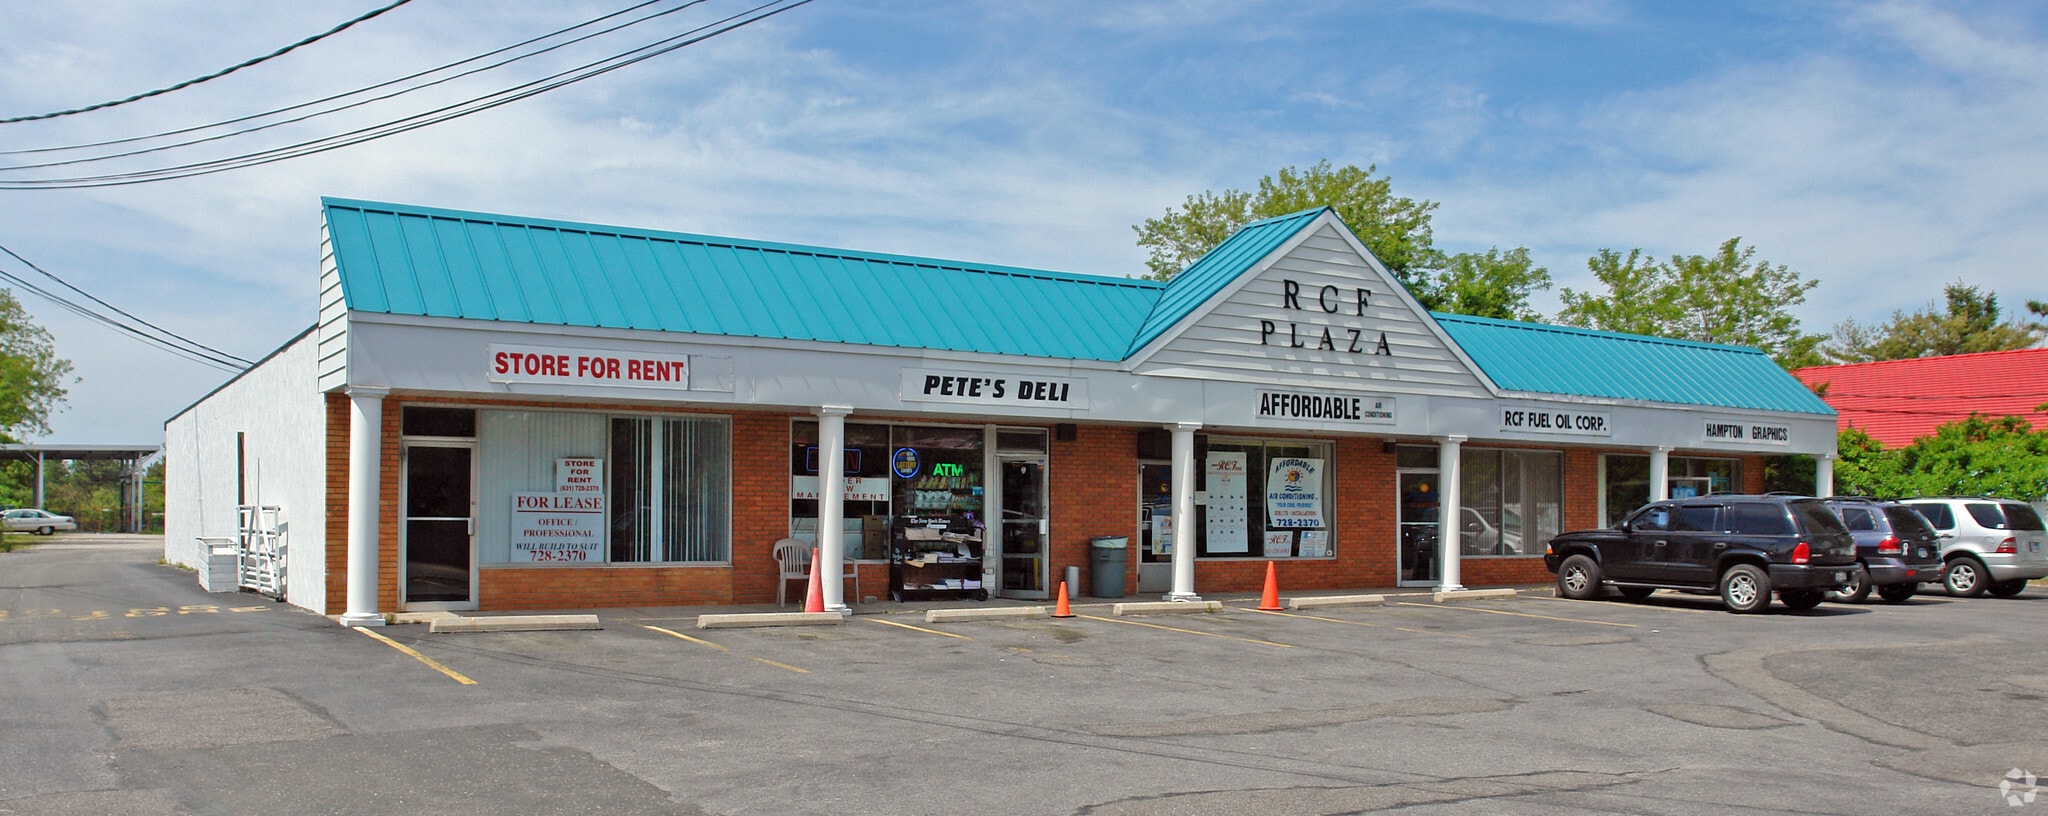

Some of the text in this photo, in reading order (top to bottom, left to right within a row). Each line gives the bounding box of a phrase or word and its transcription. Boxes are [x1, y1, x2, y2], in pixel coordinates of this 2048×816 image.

[1283, 279, 1372, 317] RCF
[1260, 320, 1392, 356] PLAZA
[495, 351, 684, 382] STORE FOR RENT
[923, 375, 1070, 402] PETE'S DELI
[1260, 392, 1361, 420] AFFORDABLE
[1505, 410, 1607, 431] RCF FUEL OIL CORP.
[1706, 423, 1788, 441] HAMPTON GRAPHICS
[896, 461, 917, 469] LOTTERY
[932, 462, 964, 477] ATM
[1275, 459, 1315, 474] AFFORDABLE
[517, 496, 602, 509] FOR LEASE
[796, 491, 885, 500] MAEMENT
[1276, 518, 1320, 527] 728-2370
[523, 529, 594, 537] PROFESSIONAL
[580, 543, 599, 551] SUIT
[530, 550, 587, 562] 728-2370
